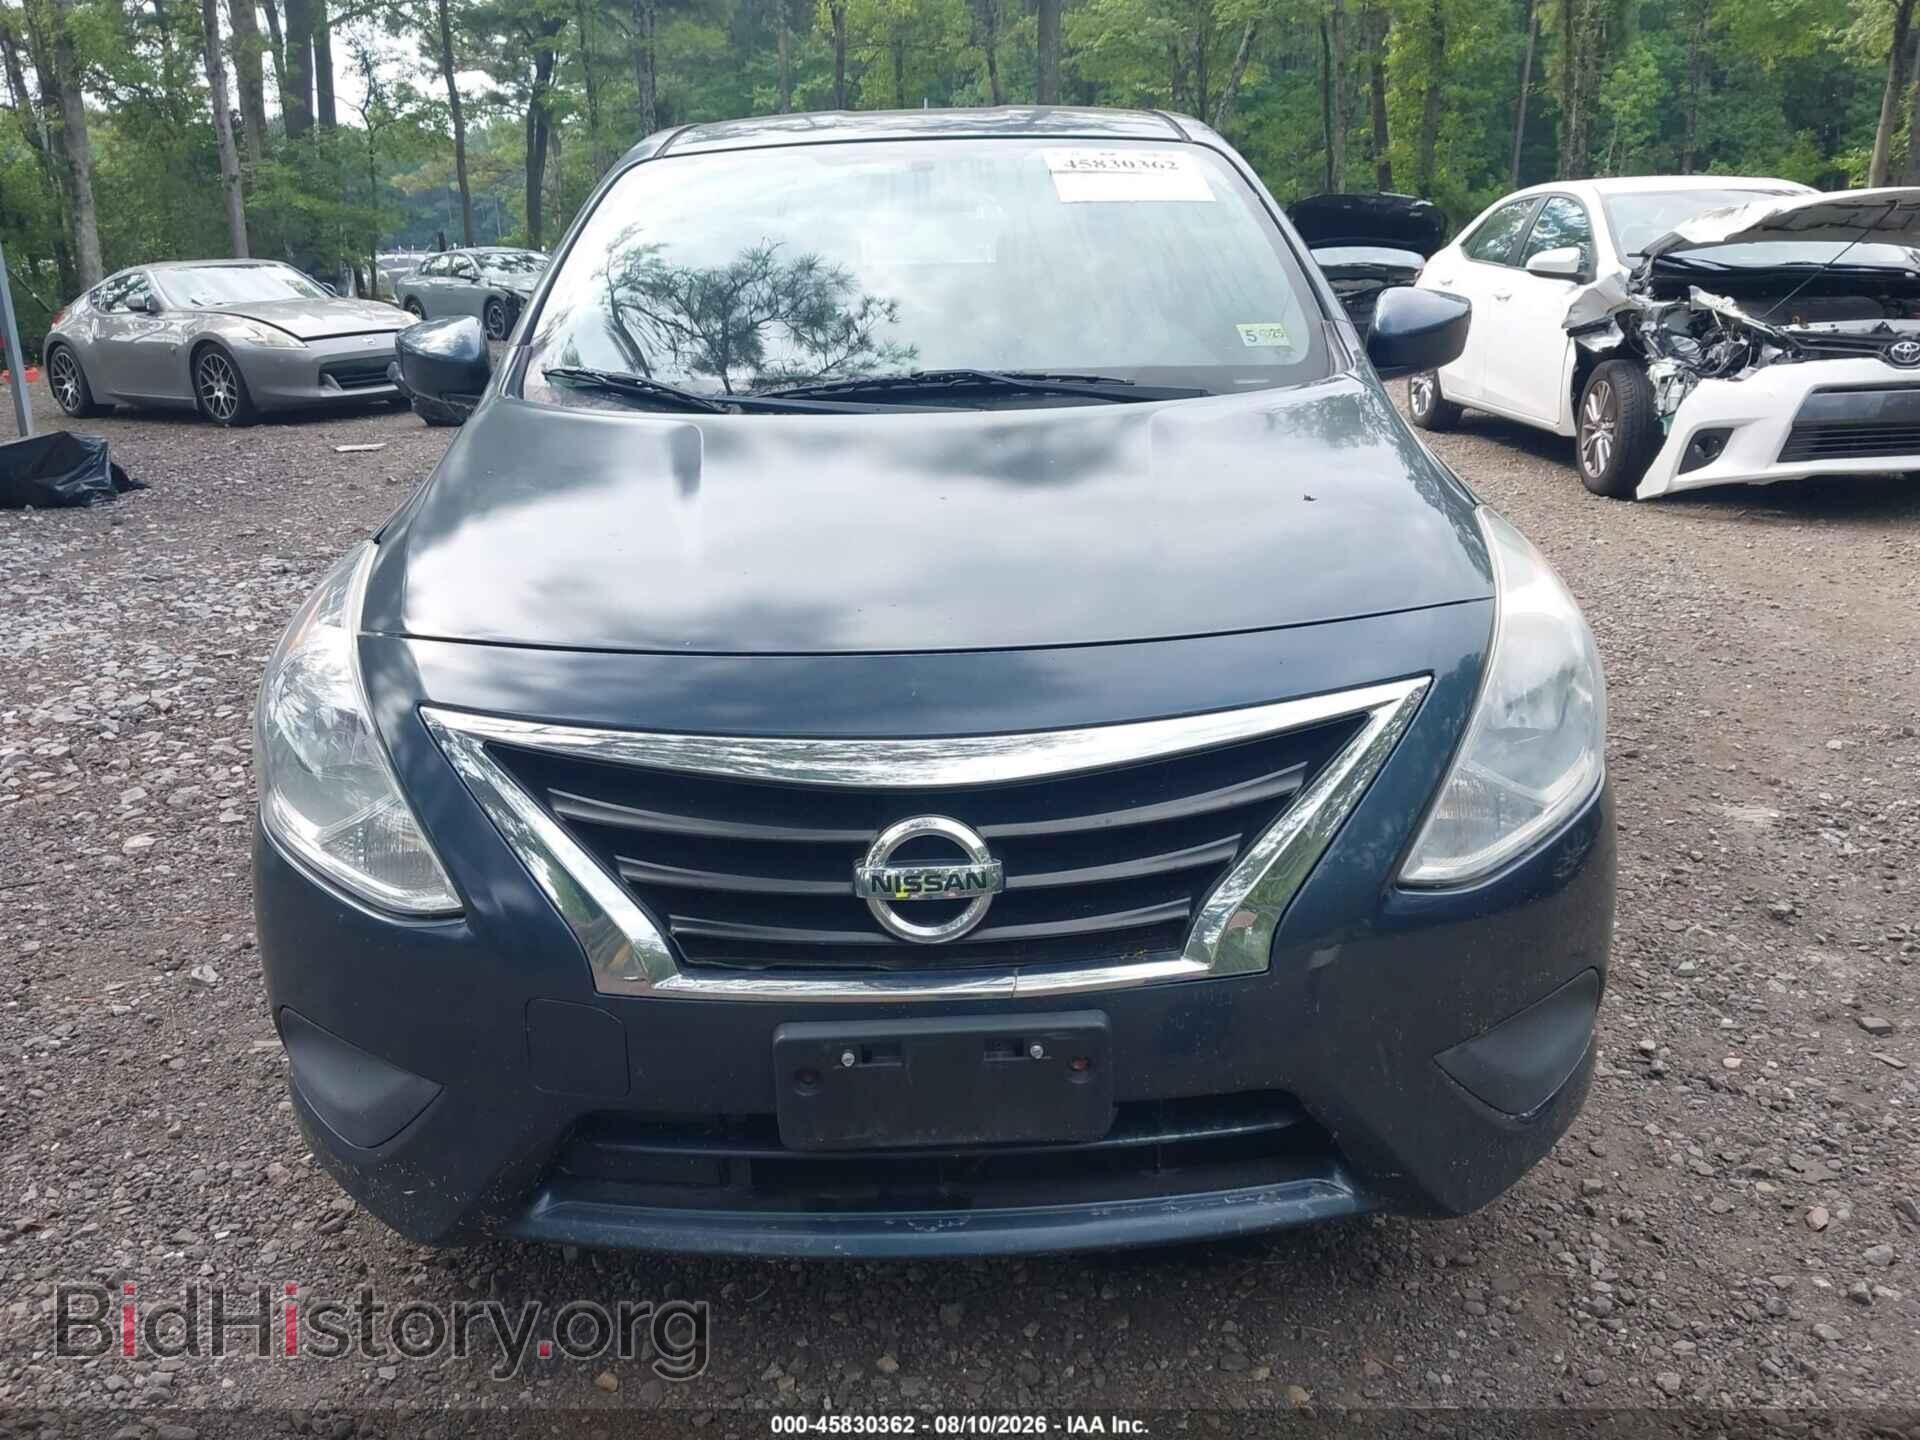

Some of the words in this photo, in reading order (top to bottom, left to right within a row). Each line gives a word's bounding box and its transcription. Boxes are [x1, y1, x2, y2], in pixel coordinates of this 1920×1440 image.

[1064, 159, 1180, 170] 45830362
[1245, 329, 1257, 343] 5
[871, 871, 987, 893] NISSAN
